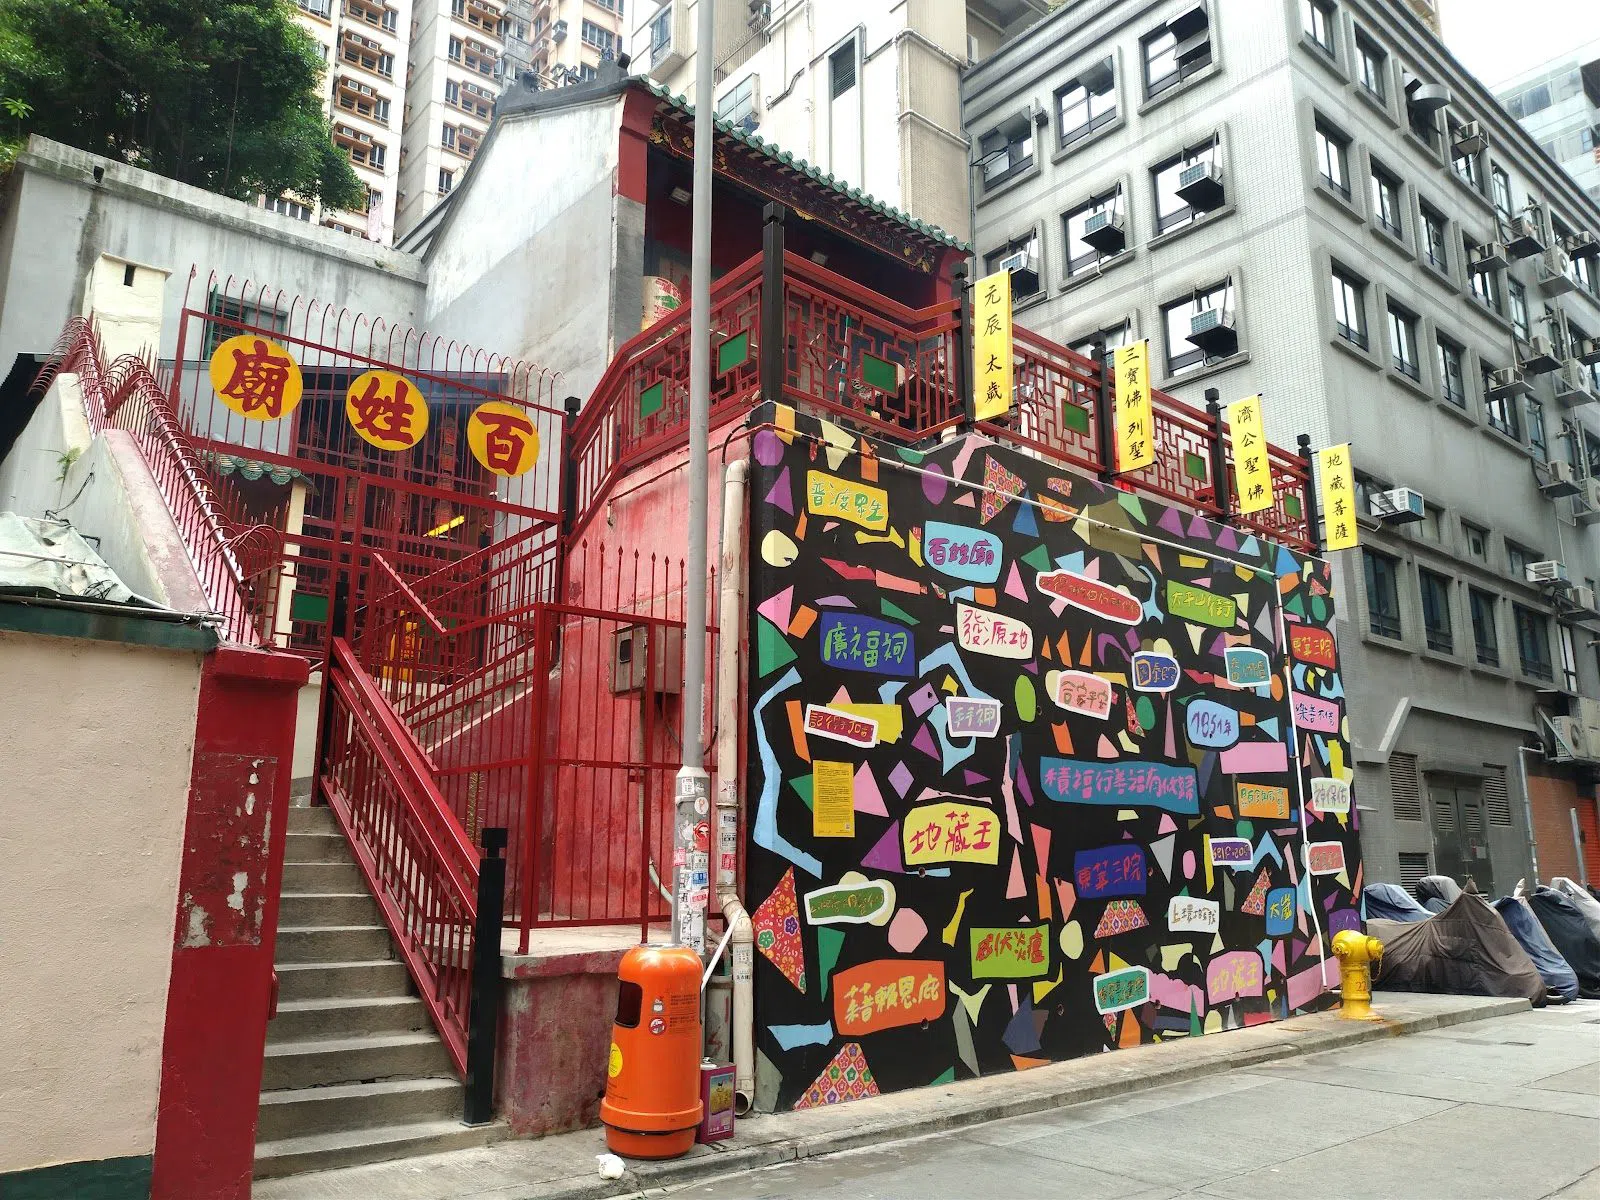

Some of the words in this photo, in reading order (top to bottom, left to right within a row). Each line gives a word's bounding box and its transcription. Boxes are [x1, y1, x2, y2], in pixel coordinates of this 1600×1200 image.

[220, 340, 291, 418] 廟
[350, 376, 415, 446] 姓
[1123, 347, 1145, 461] 三寶佛列聖
[475, 411, 534, 475] 百
[1237, 405, 1264, 501] 濟公聖佛
[1327, 453, 1349, 540] 地藏菩薩
[928, 537, 995, 567] 百姓廟
[823, 621, 908, 668] 廣福祠
[910, 810, 993, 856] 地藏王
